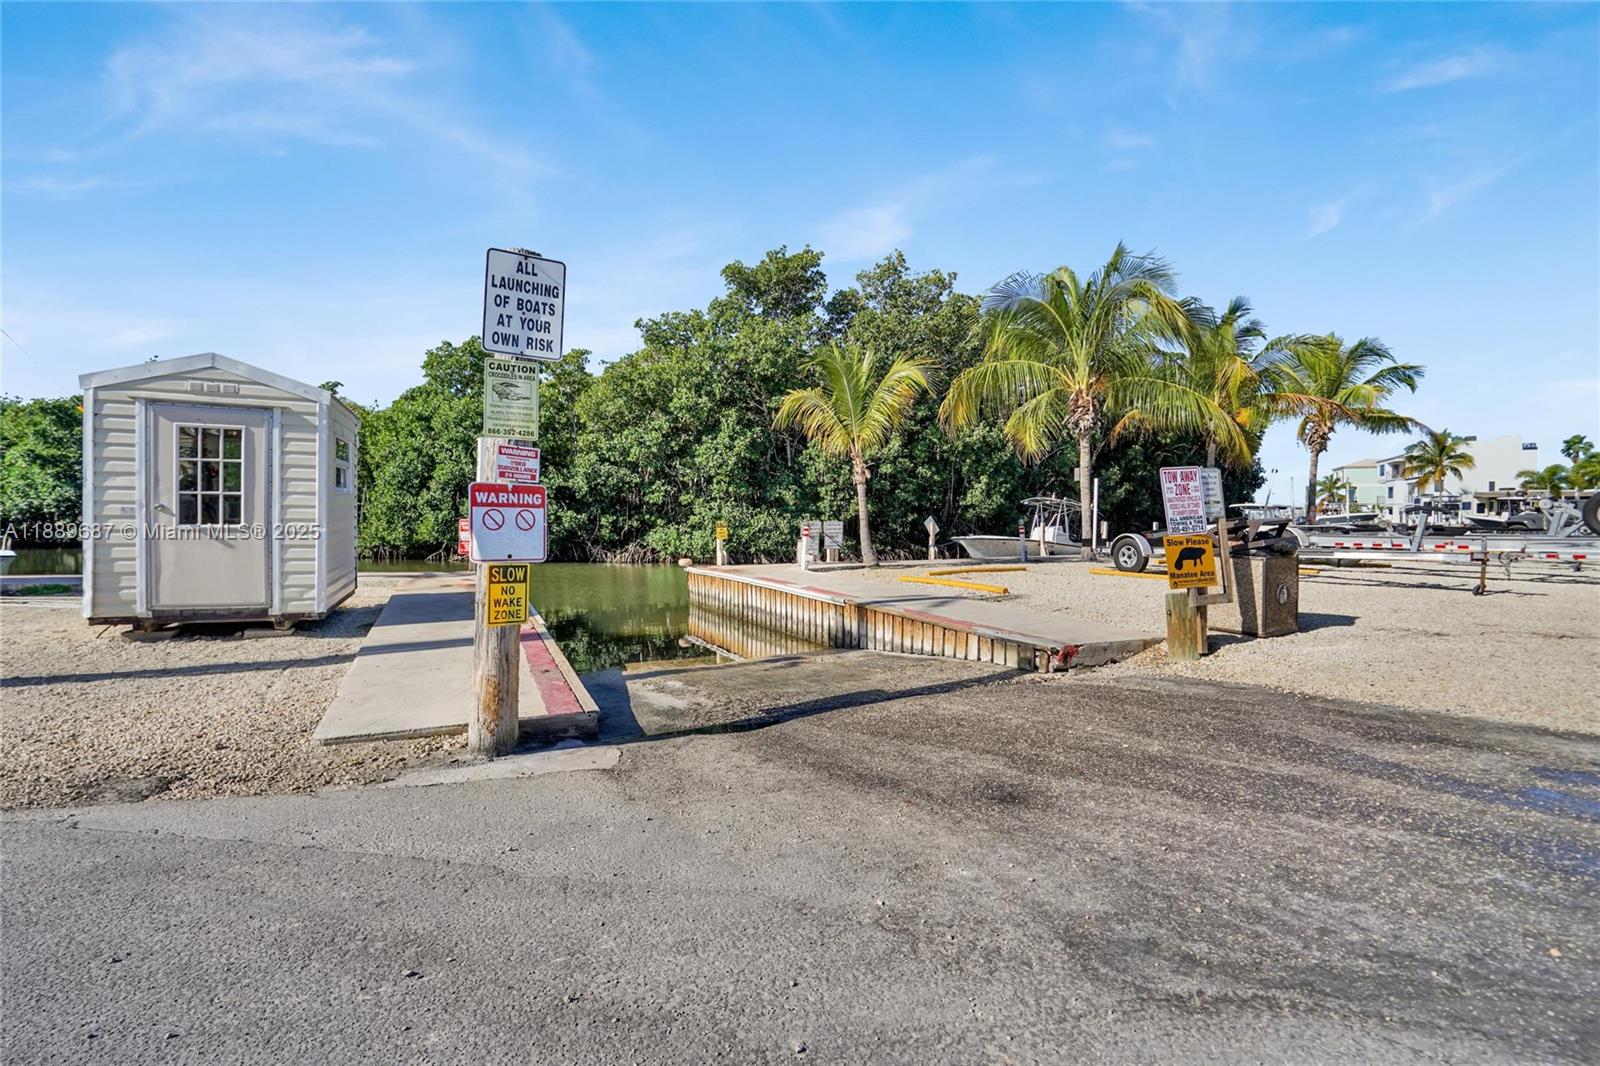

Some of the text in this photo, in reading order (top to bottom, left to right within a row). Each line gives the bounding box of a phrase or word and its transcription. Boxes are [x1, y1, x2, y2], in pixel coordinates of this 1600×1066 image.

[516, 261, 538, 276] ALL
[491, 274, 559, 298] LAUNCHING
[494, 294, 556, 316] OF BOATS
[497, 314, 551, 334] AT YOUR
[492, 331, 554, 352] OWN RISK
[488, 362, 536, 374] CAUTION
[488, 371, 516, 380] CROCODILES
[488, 428, 534, 436] 866-392-4286
[501, 448, 536, 458] WARNING
[1164, 470, 1197, 483] TOW AWAY
[1174, 484, 1191, 495] ZONE
[475, 492, 542, 504] WARNING
[491, 568, 525, 582] SLOW
[501, 586, 515, 595] NO
[494, 597, 522, 608] WAKE
[494, 609, 522, 620] ZONE
